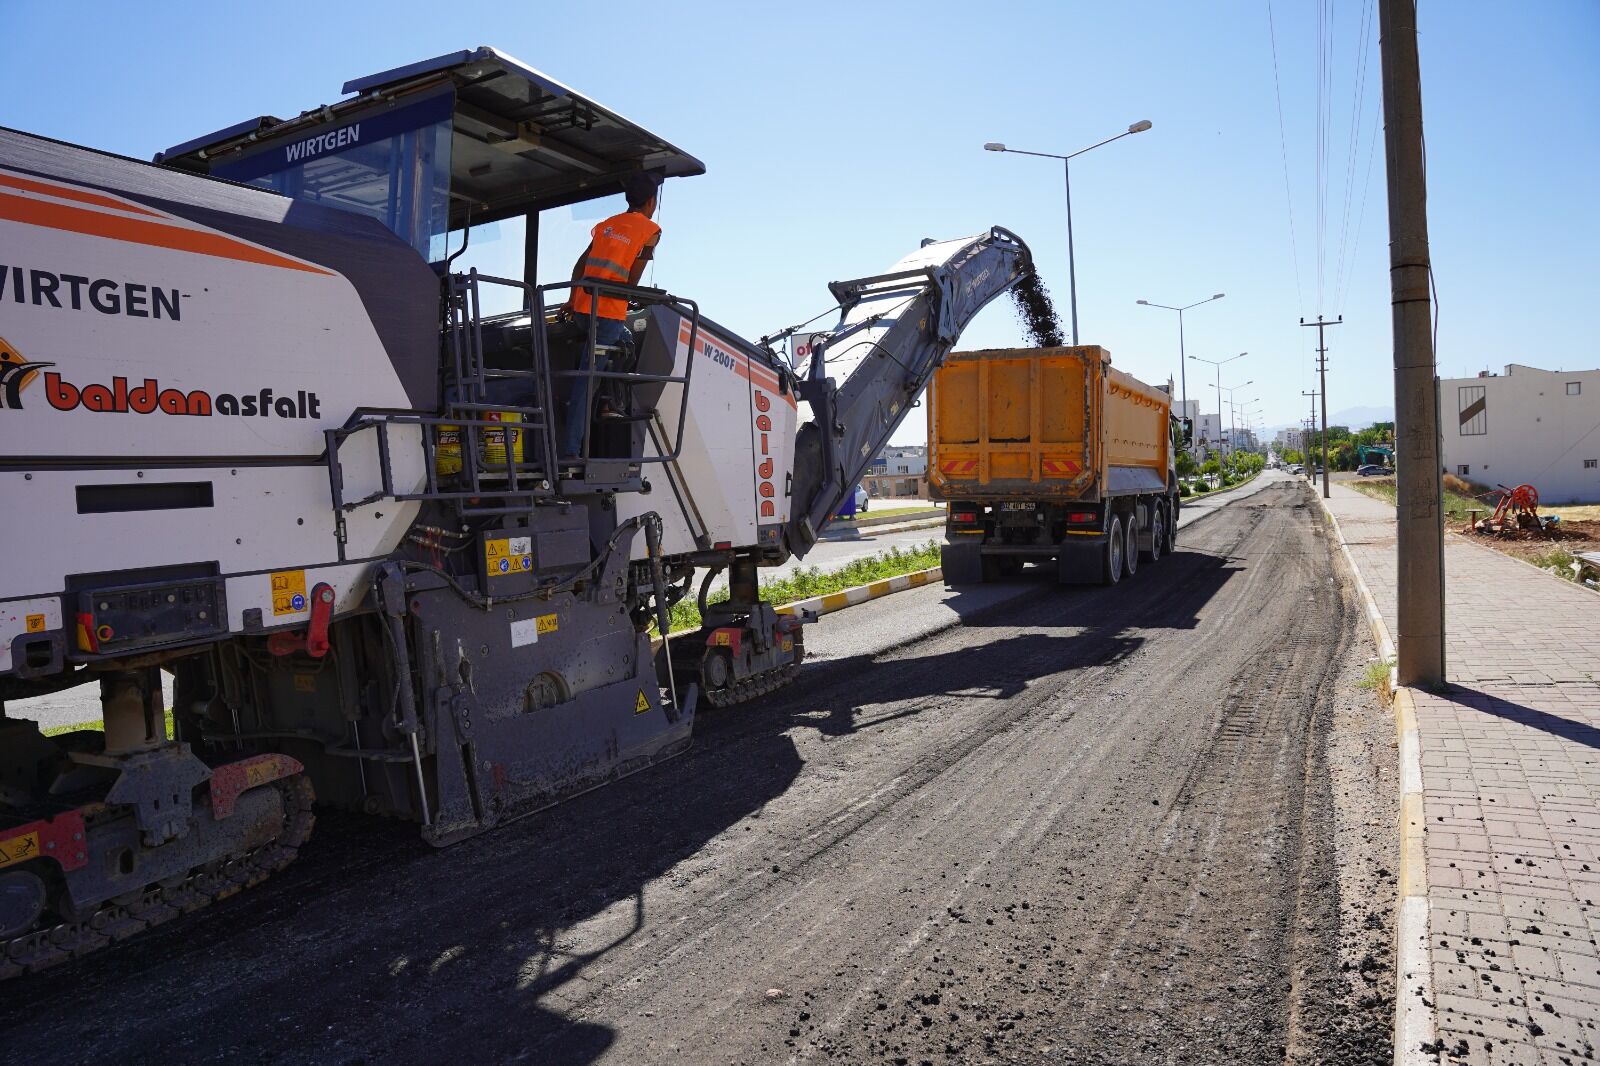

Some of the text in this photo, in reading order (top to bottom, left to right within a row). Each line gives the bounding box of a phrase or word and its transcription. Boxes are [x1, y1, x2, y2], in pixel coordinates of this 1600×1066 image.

[286, 123, 360, 163] WIRTGEN
[0, 265, 181, 322] IRTGEN
[703, 342, 712, 359] W
[44, 371, 321, 420] baldan asfalt
[754, 389, 774, 517] baldan
